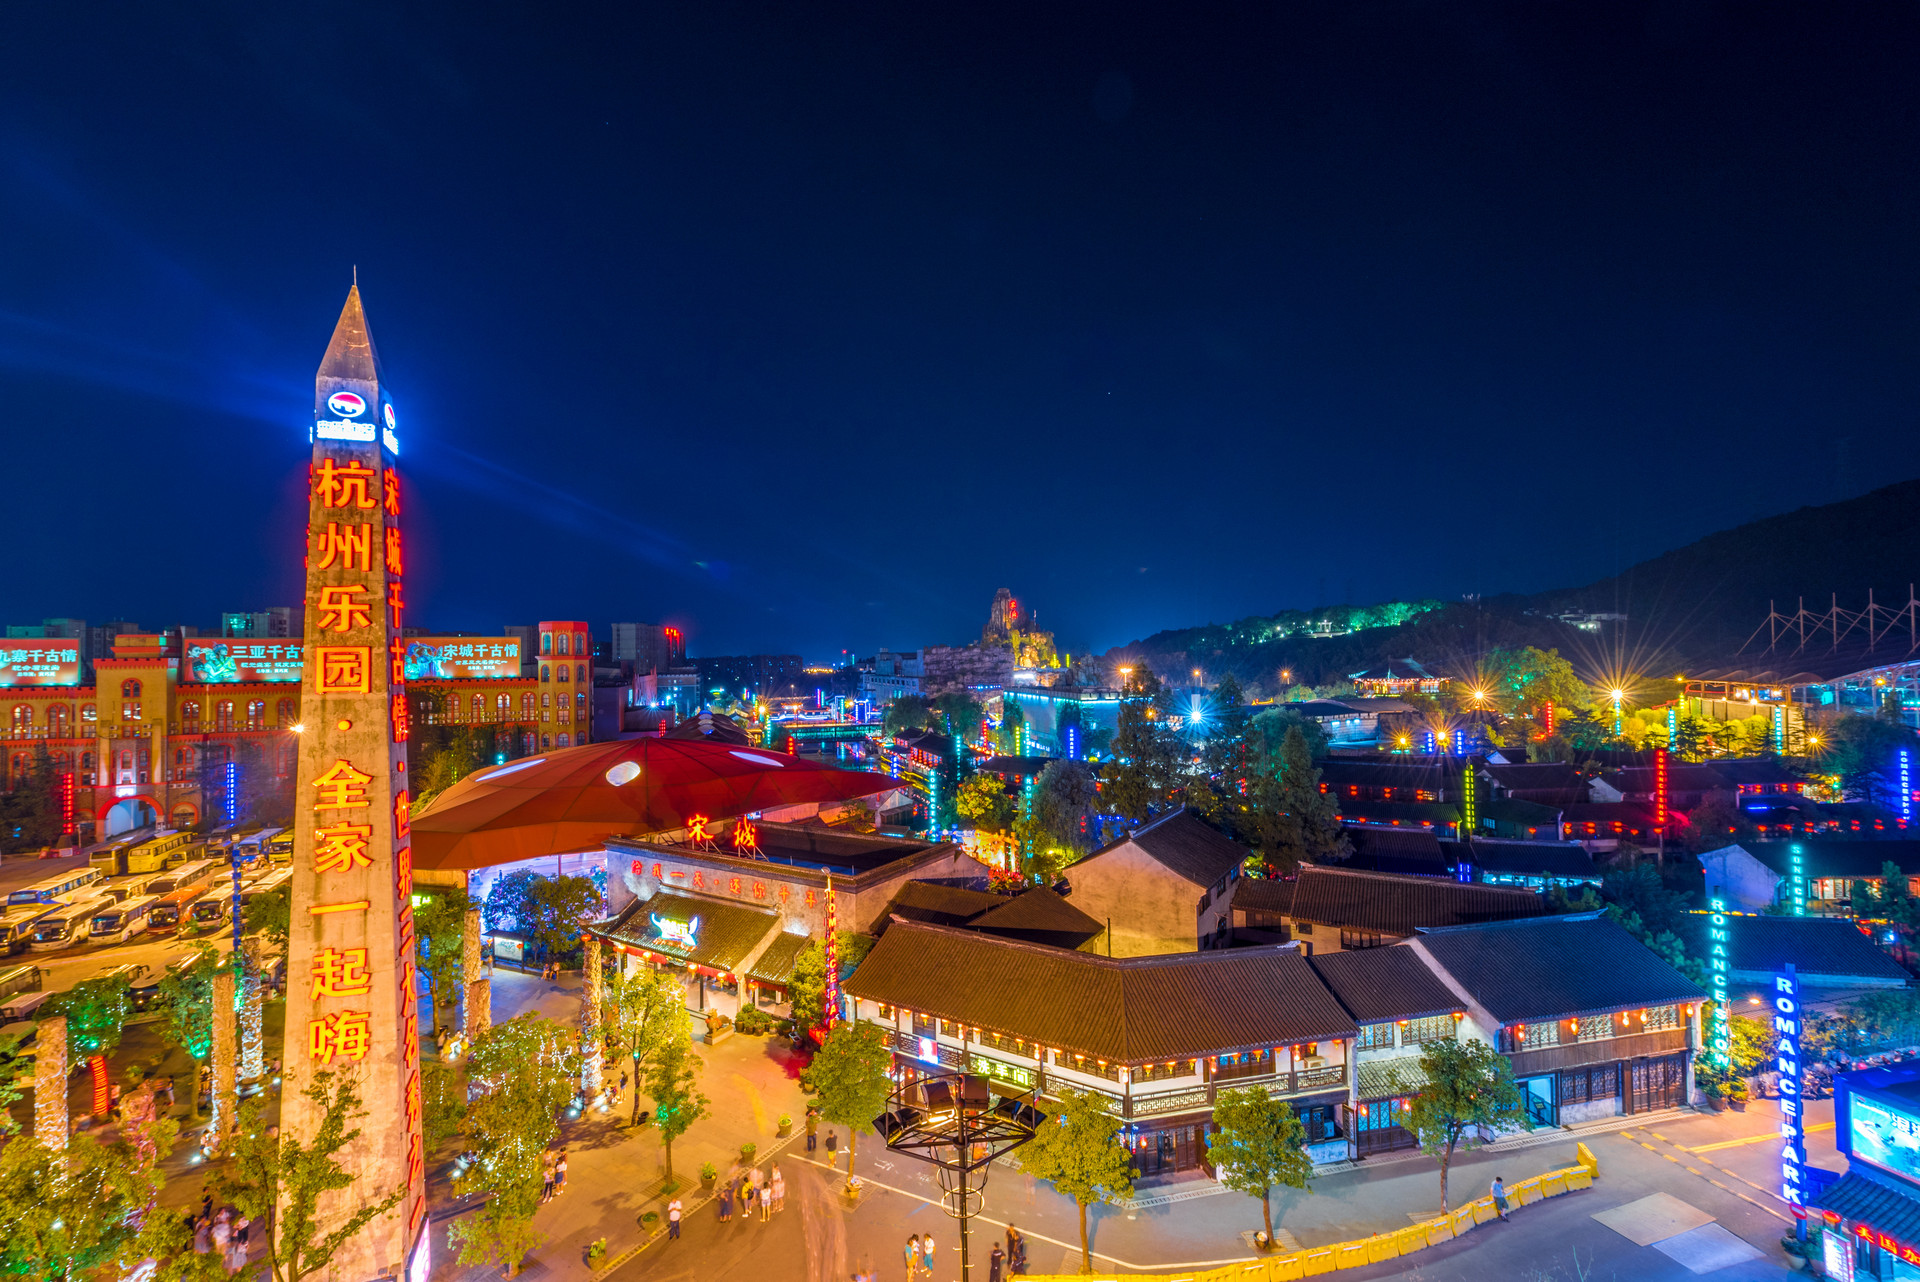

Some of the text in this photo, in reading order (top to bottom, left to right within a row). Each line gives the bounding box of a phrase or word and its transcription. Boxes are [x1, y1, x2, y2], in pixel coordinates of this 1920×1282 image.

[230, 644, 304, 660] 三亚千古
[443, 643, 519, 658] 宋城千古情
[688, 813, 757, 848] 宋城
[630, 859, 818, 910] 给我一天·还你千年
[828, 888, 838, 984] ROMANCE
[1710, 898, 1730, 1068] ROMANCE SHOW
[976, 1057, 1030, 1087] 洗手间
[1775, 976, 1801, 1206] ROMANCE PARK
[1890, 1111, 1920, 1139] 浪
